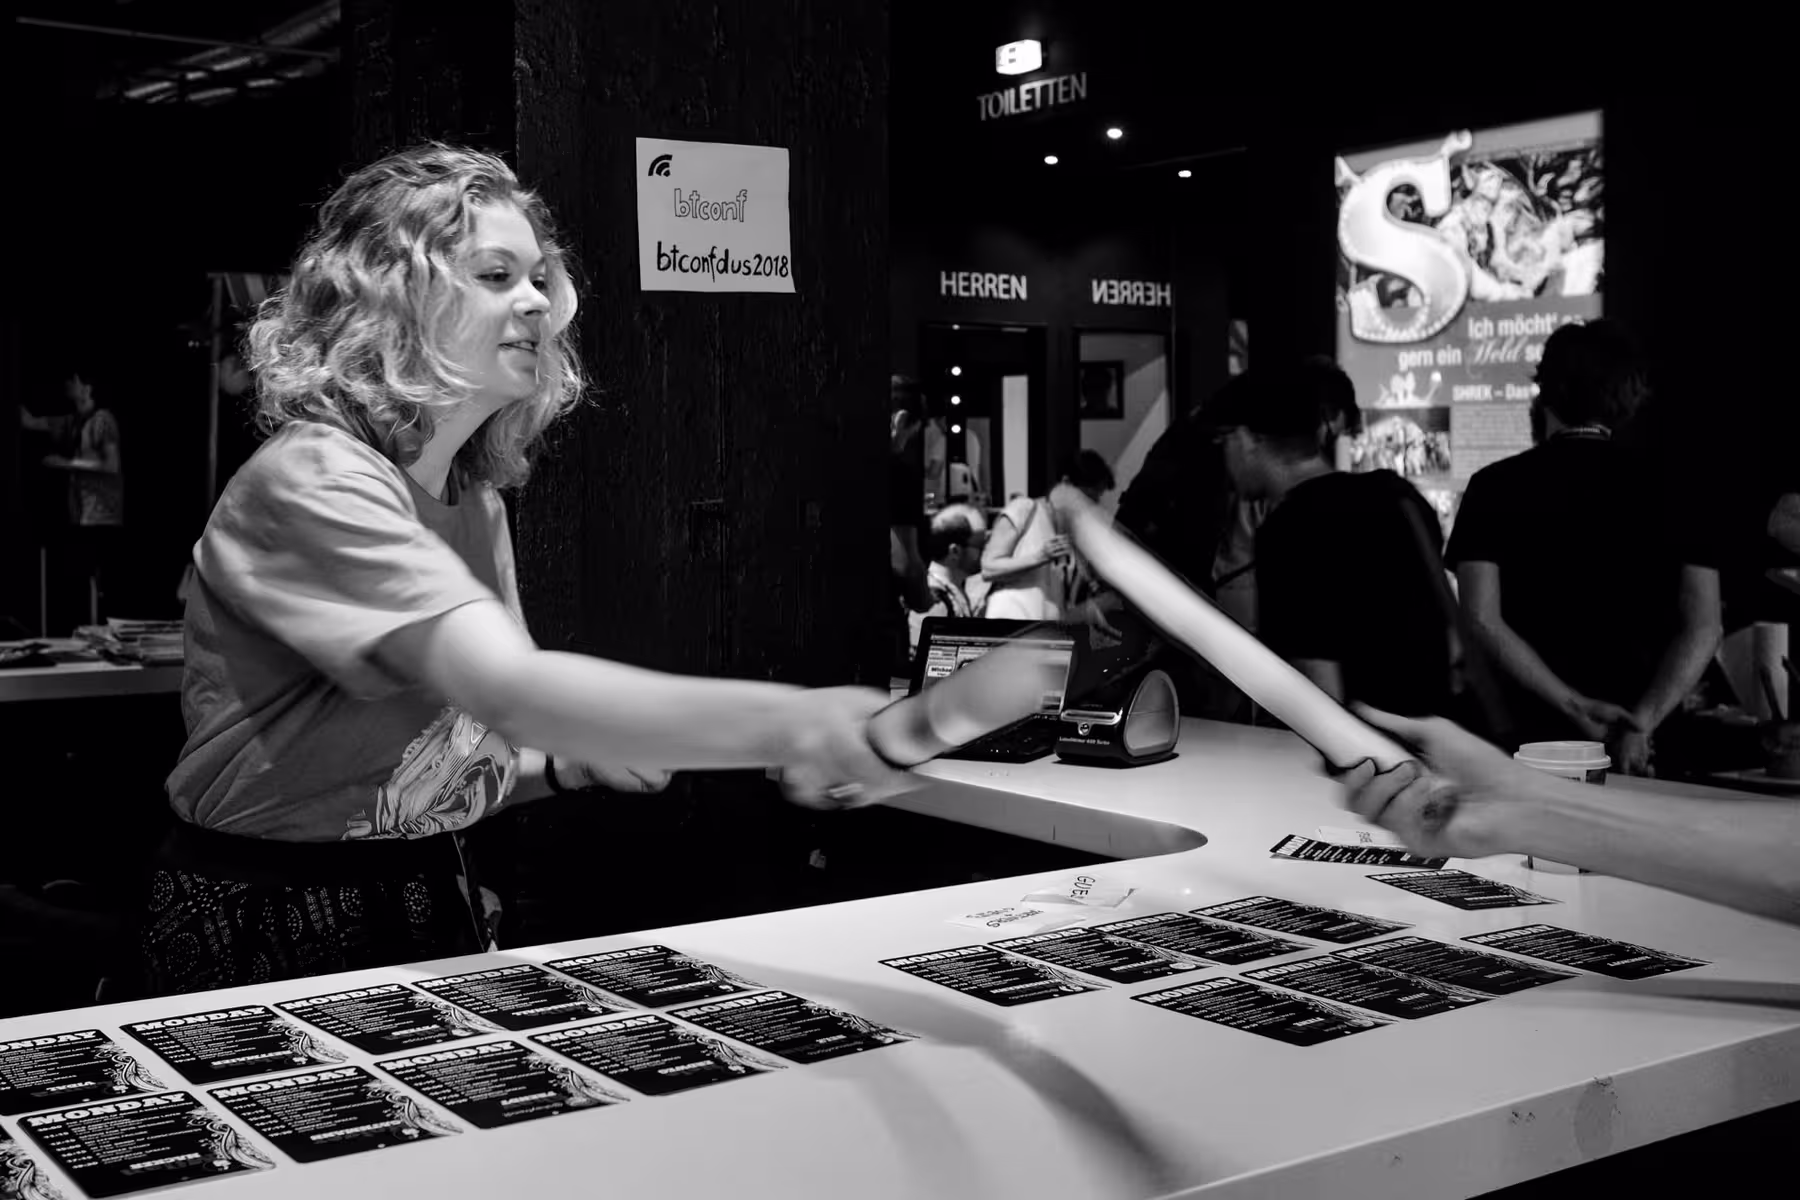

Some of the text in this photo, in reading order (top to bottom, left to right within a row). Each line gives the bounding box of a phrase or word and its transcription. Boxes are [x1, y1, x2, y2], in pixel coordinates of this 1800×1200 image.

[977, 72, 1087, 120] TOILETTEN
[674, 188, 748, 222] btconf
[656, 241, 789, 283] btconfdus2018
[940, 271, 1028, 300] HERREN
[1468, 316, 1494, 339] Ich
[1398, 349, 1434, 371] gern
[1437, 344, 1462, 365] ein
[1452, 384, 1493, 401] SHREK
[1096, 913, 1183, 932] MONDAY
[995, 928, 1088, 948] MONDAY
[551, 947, 658, 969] MONDAY
[885, 946, 989, 967] MONDAY
[1248, 956, 1341, 979] MONDAY
[419, 966, 533, 988] MONDAY
[280, 984, 401, 1010] MONDAY
[1138, 978, 1238, 1003] MONDAY
[673, 992, 787, 1018] MONDAY
[132, 1007, 265, 1032] MONDAY
[534, 1016, 660, 1043] MONDAY
[0, 1031, 97, 1051] NDAY
[380, 1041, 515, 1070] MONDAY
[213, 1068, 358, 1099] MONDAY
[27, 1093, 185, 1127] MONDAY
